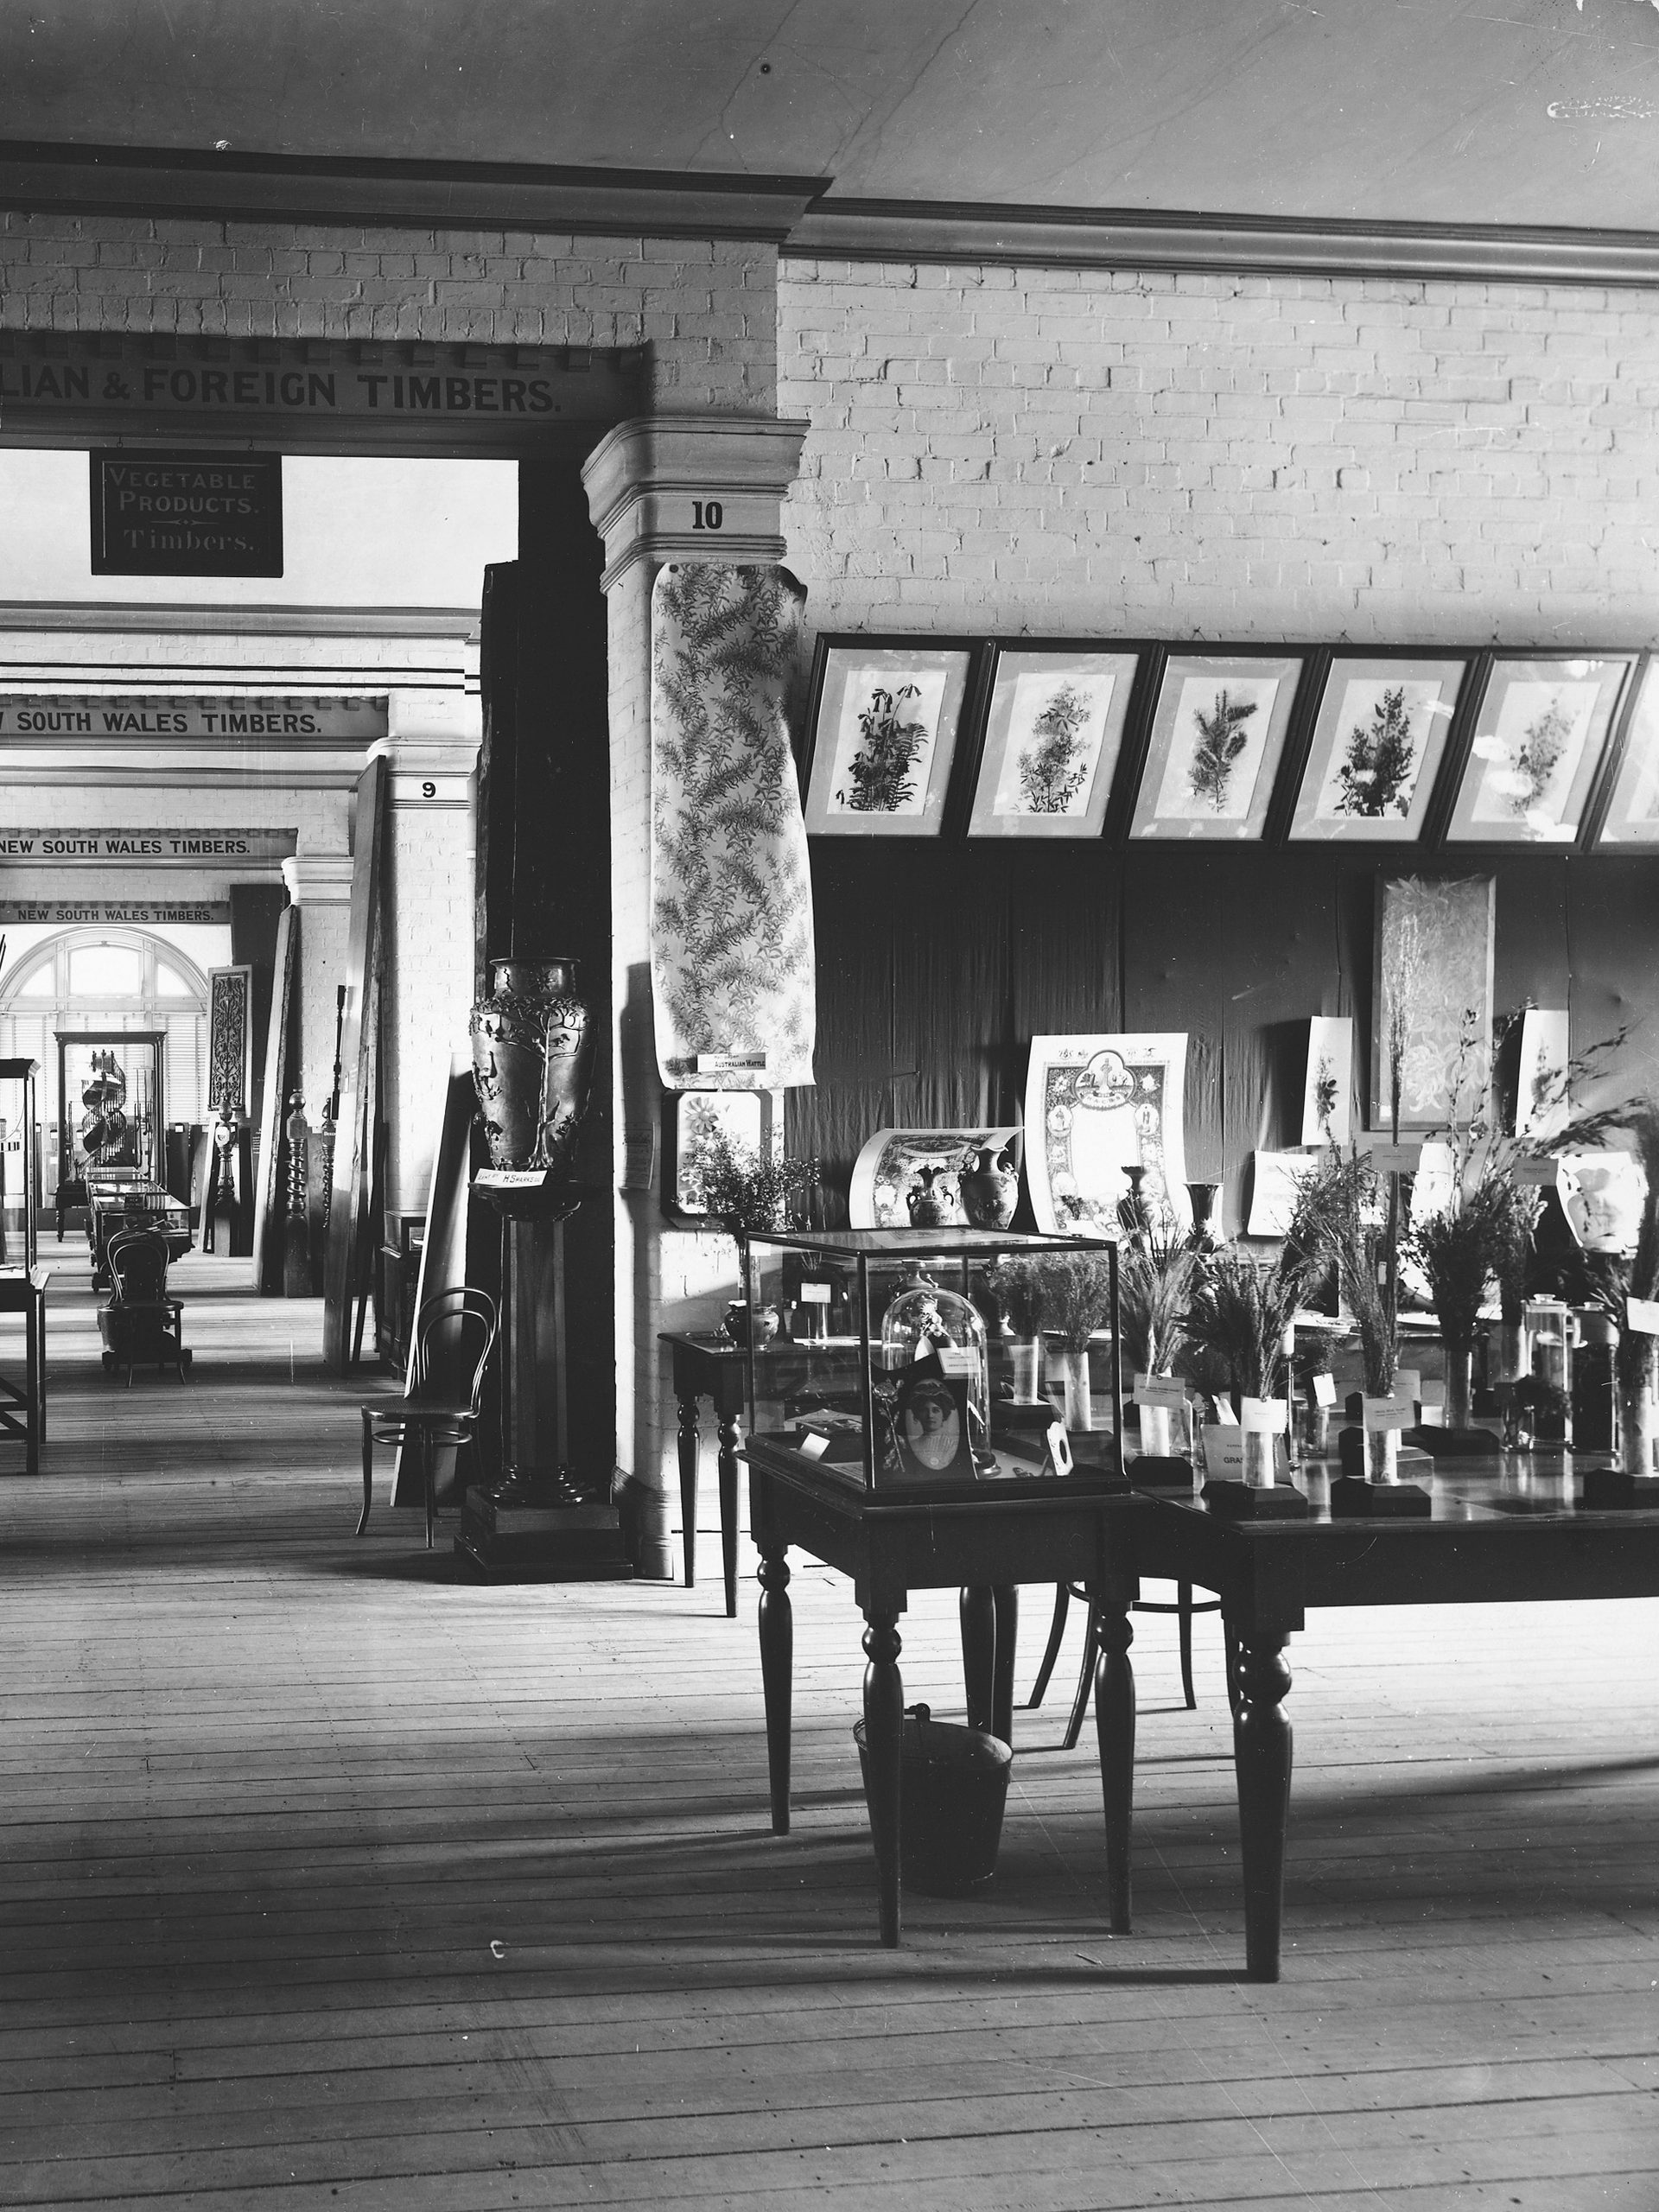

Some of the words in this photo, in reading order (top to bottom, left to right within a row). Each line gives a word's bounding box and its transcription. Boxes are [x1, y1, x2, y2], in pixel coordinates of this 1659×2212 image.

[102, 369, 130, 400] &
[143, 369, 336, 408] FOREIGN
[357, 375, 562, 413] TIMBERS.
[109, 467, 256, 490] VEGETABLE
[119, 490, 260, 514] PRODUCTS.
[692, 501, 722, 529] 10
[124, 529, 255, 551] Timbers.
[17, 712, 92, 732] SOUTH
[102, 713, 188, 734] WALES
[201, 713, 322, 734] TIMBERS.
[422, 781, 436, 798] 9
[42, 840, 98, 854] SOUTH
[106, 840, 162, 854] WALES
[169, 840, 251, 855] TIMBERS.
[17, 910, 48, 920] NEW
[56, 911, 99, 921] SOUTH
[105, 911, 149, 921] WALES
[155, 911, 213, 921] TIMBERS.
